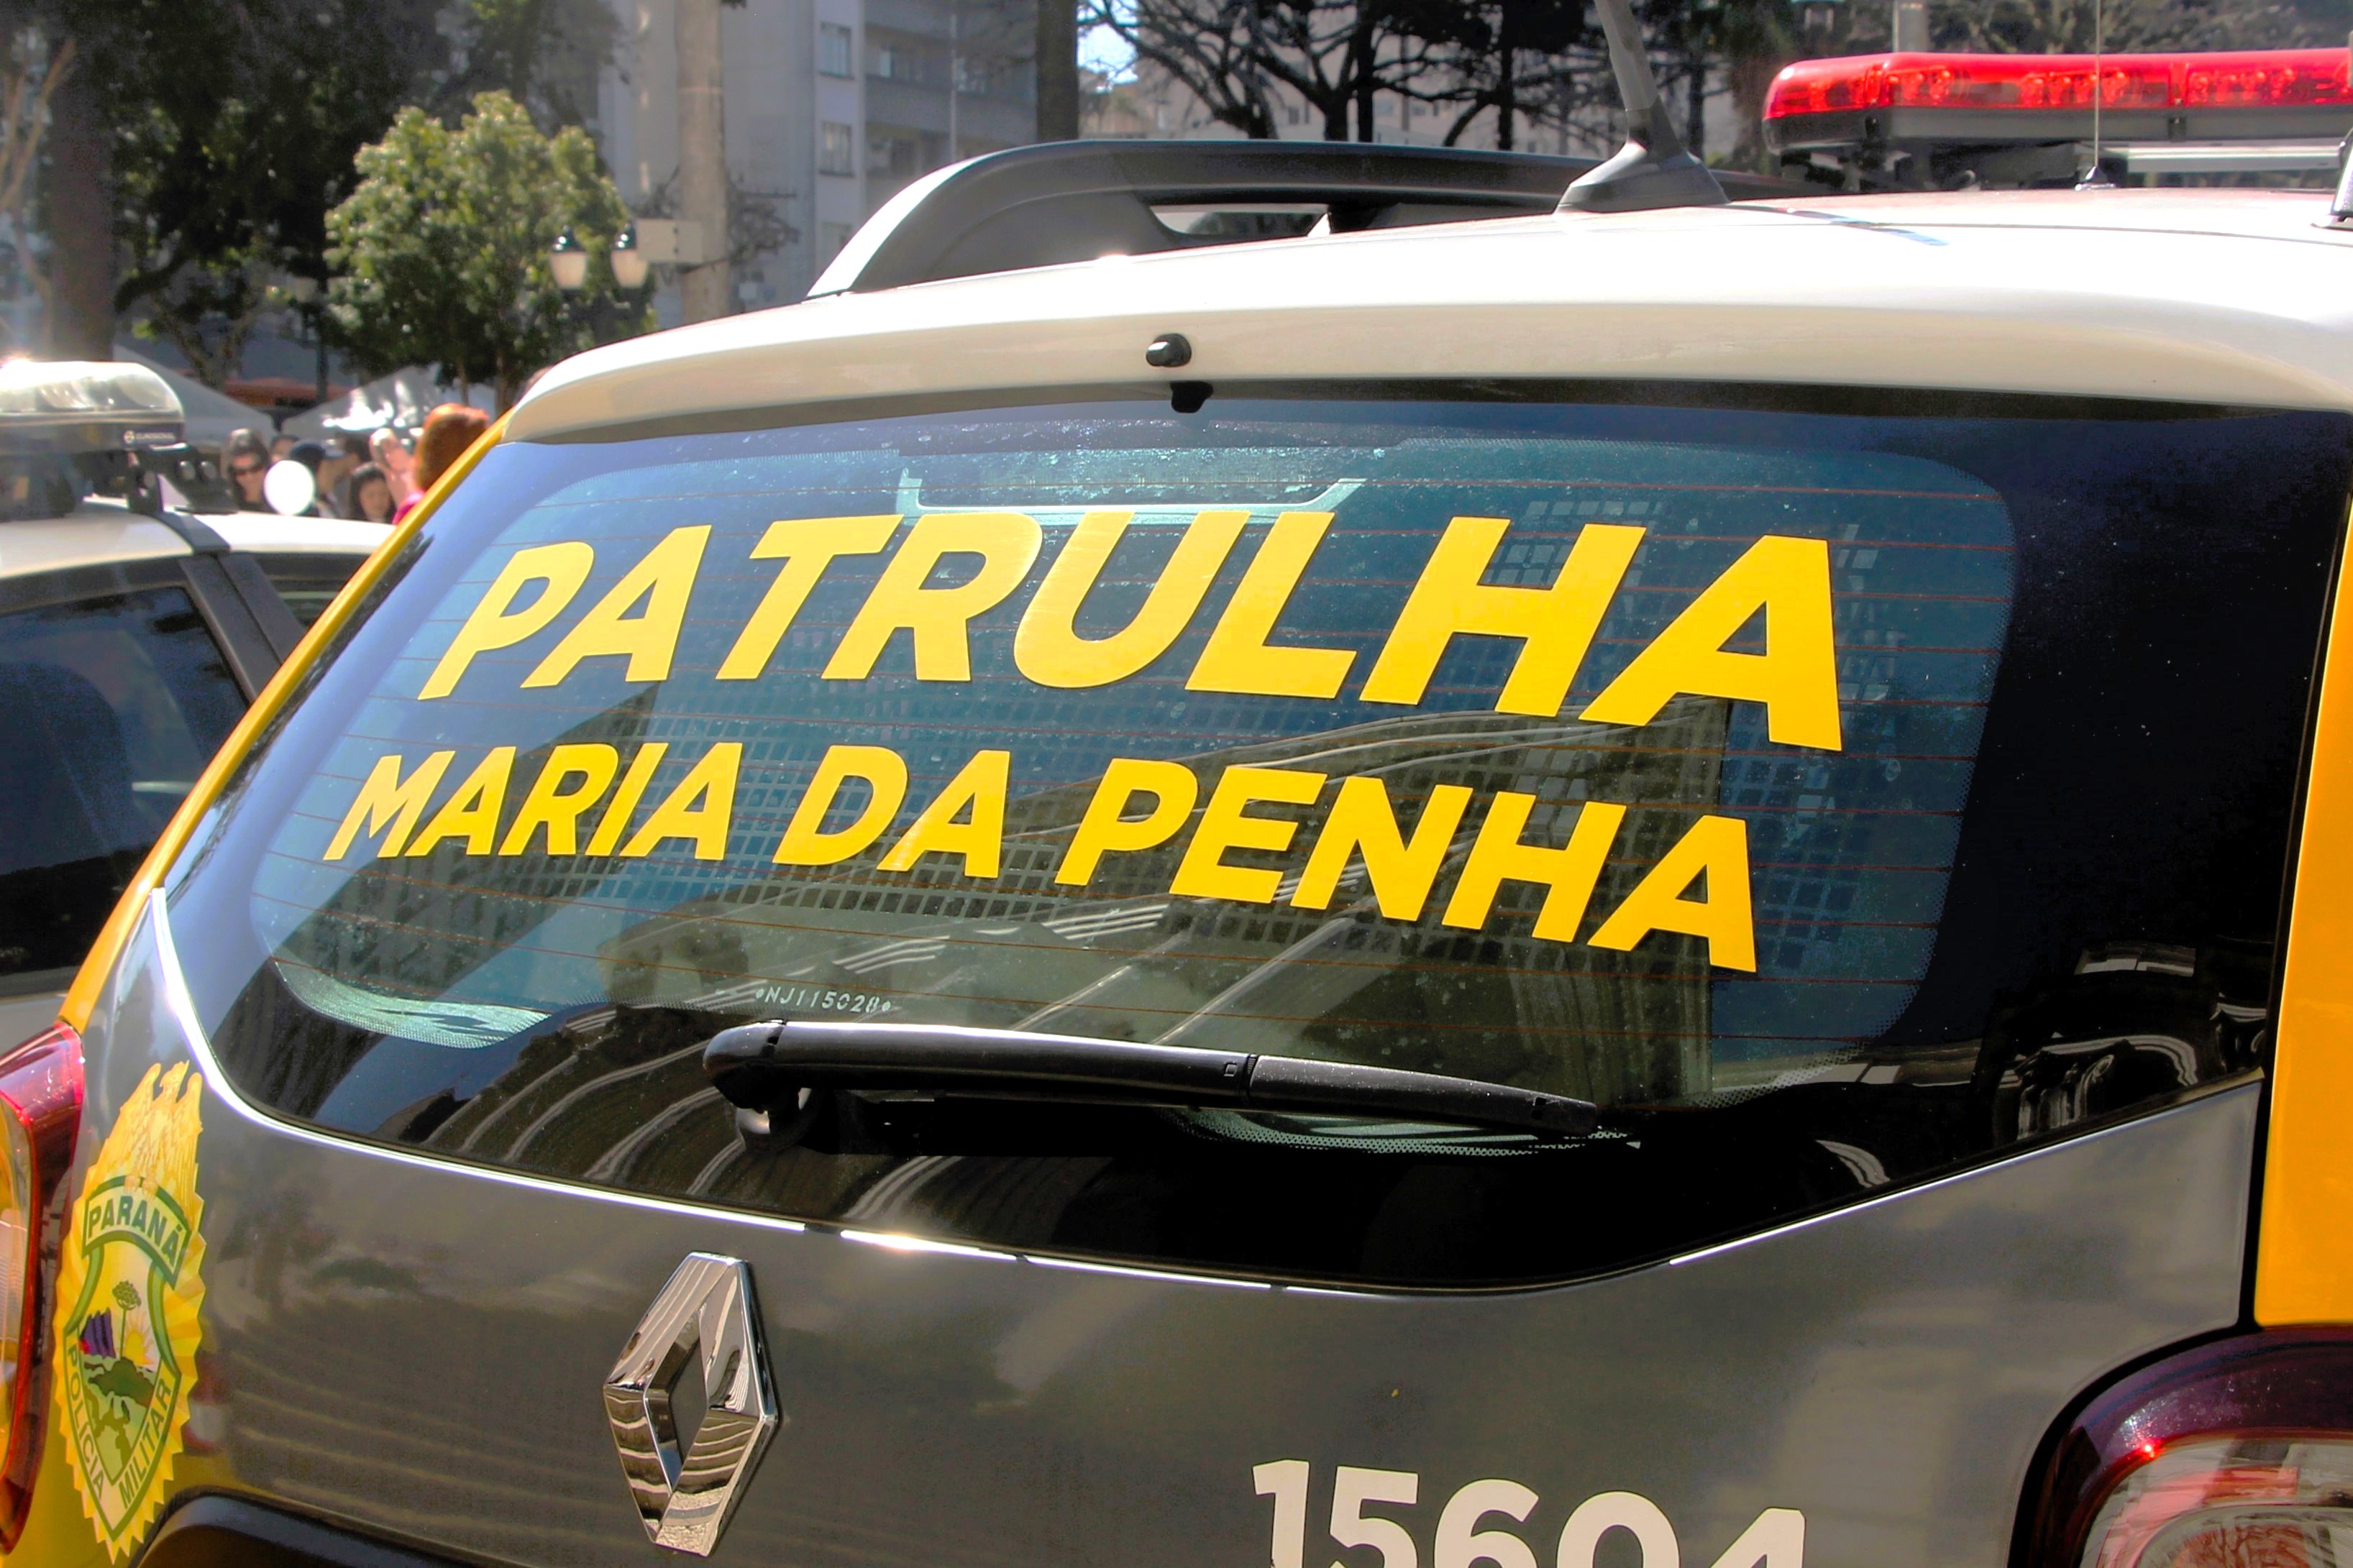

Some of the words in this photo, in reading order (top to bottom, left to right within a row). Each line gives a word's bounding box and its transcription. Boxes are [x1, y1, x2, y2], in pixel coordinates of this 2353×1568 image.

[417, 511, 1842, 752] PATRULHA
[323, 742, 744, 861] MARIA
[772, 745, 1011, 879] DA
[1054, 758, 1757, 973] PENHA
[88, 1195, 183, 1267] PARANÁ
[118, 1377, 172, 1510] MILITAR
